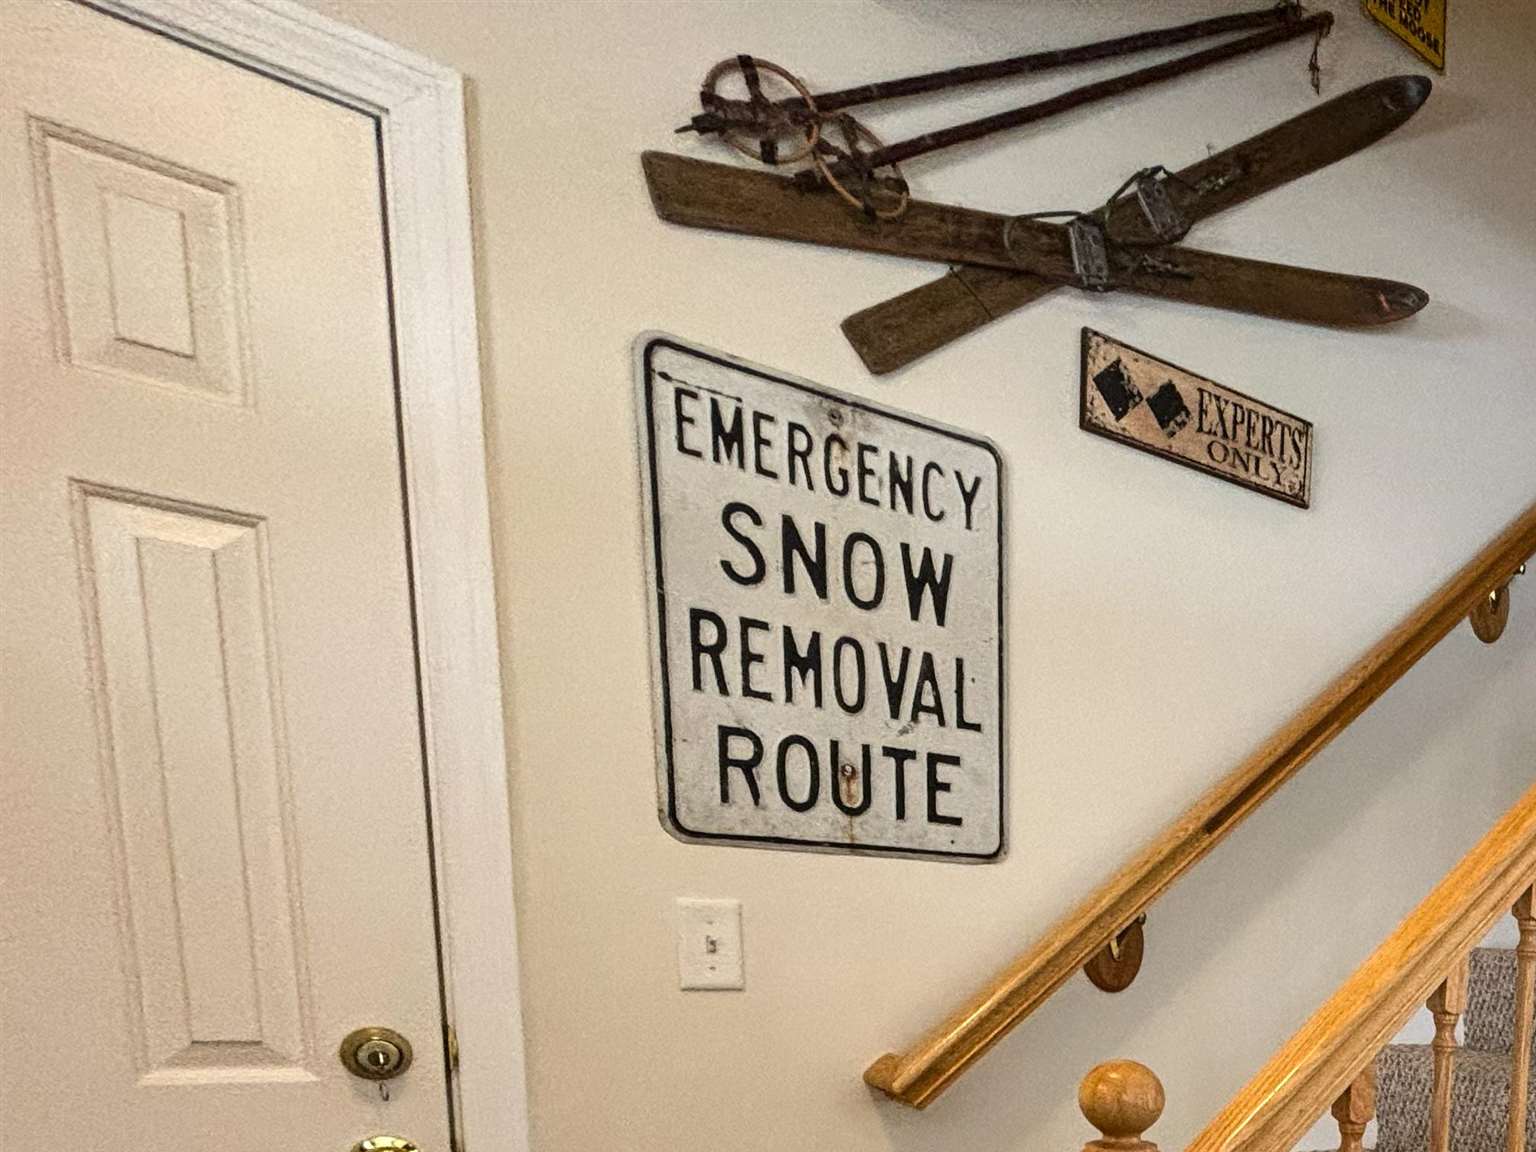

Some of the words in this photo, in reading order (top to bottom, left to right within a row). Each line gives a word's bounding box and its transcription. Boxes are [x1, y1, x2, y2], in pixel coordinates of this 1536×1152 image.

[673, 386, 982, 530] EMERGENCY
[1196, 387, 1304, 470] EXPERTS
[1207, 440, 1288, 486] ONLY
[720, 501, 953, 627] SNOW
[689, 607, 983, 732] REMOVAL
[717, 725, 963, 826] ROUTE
